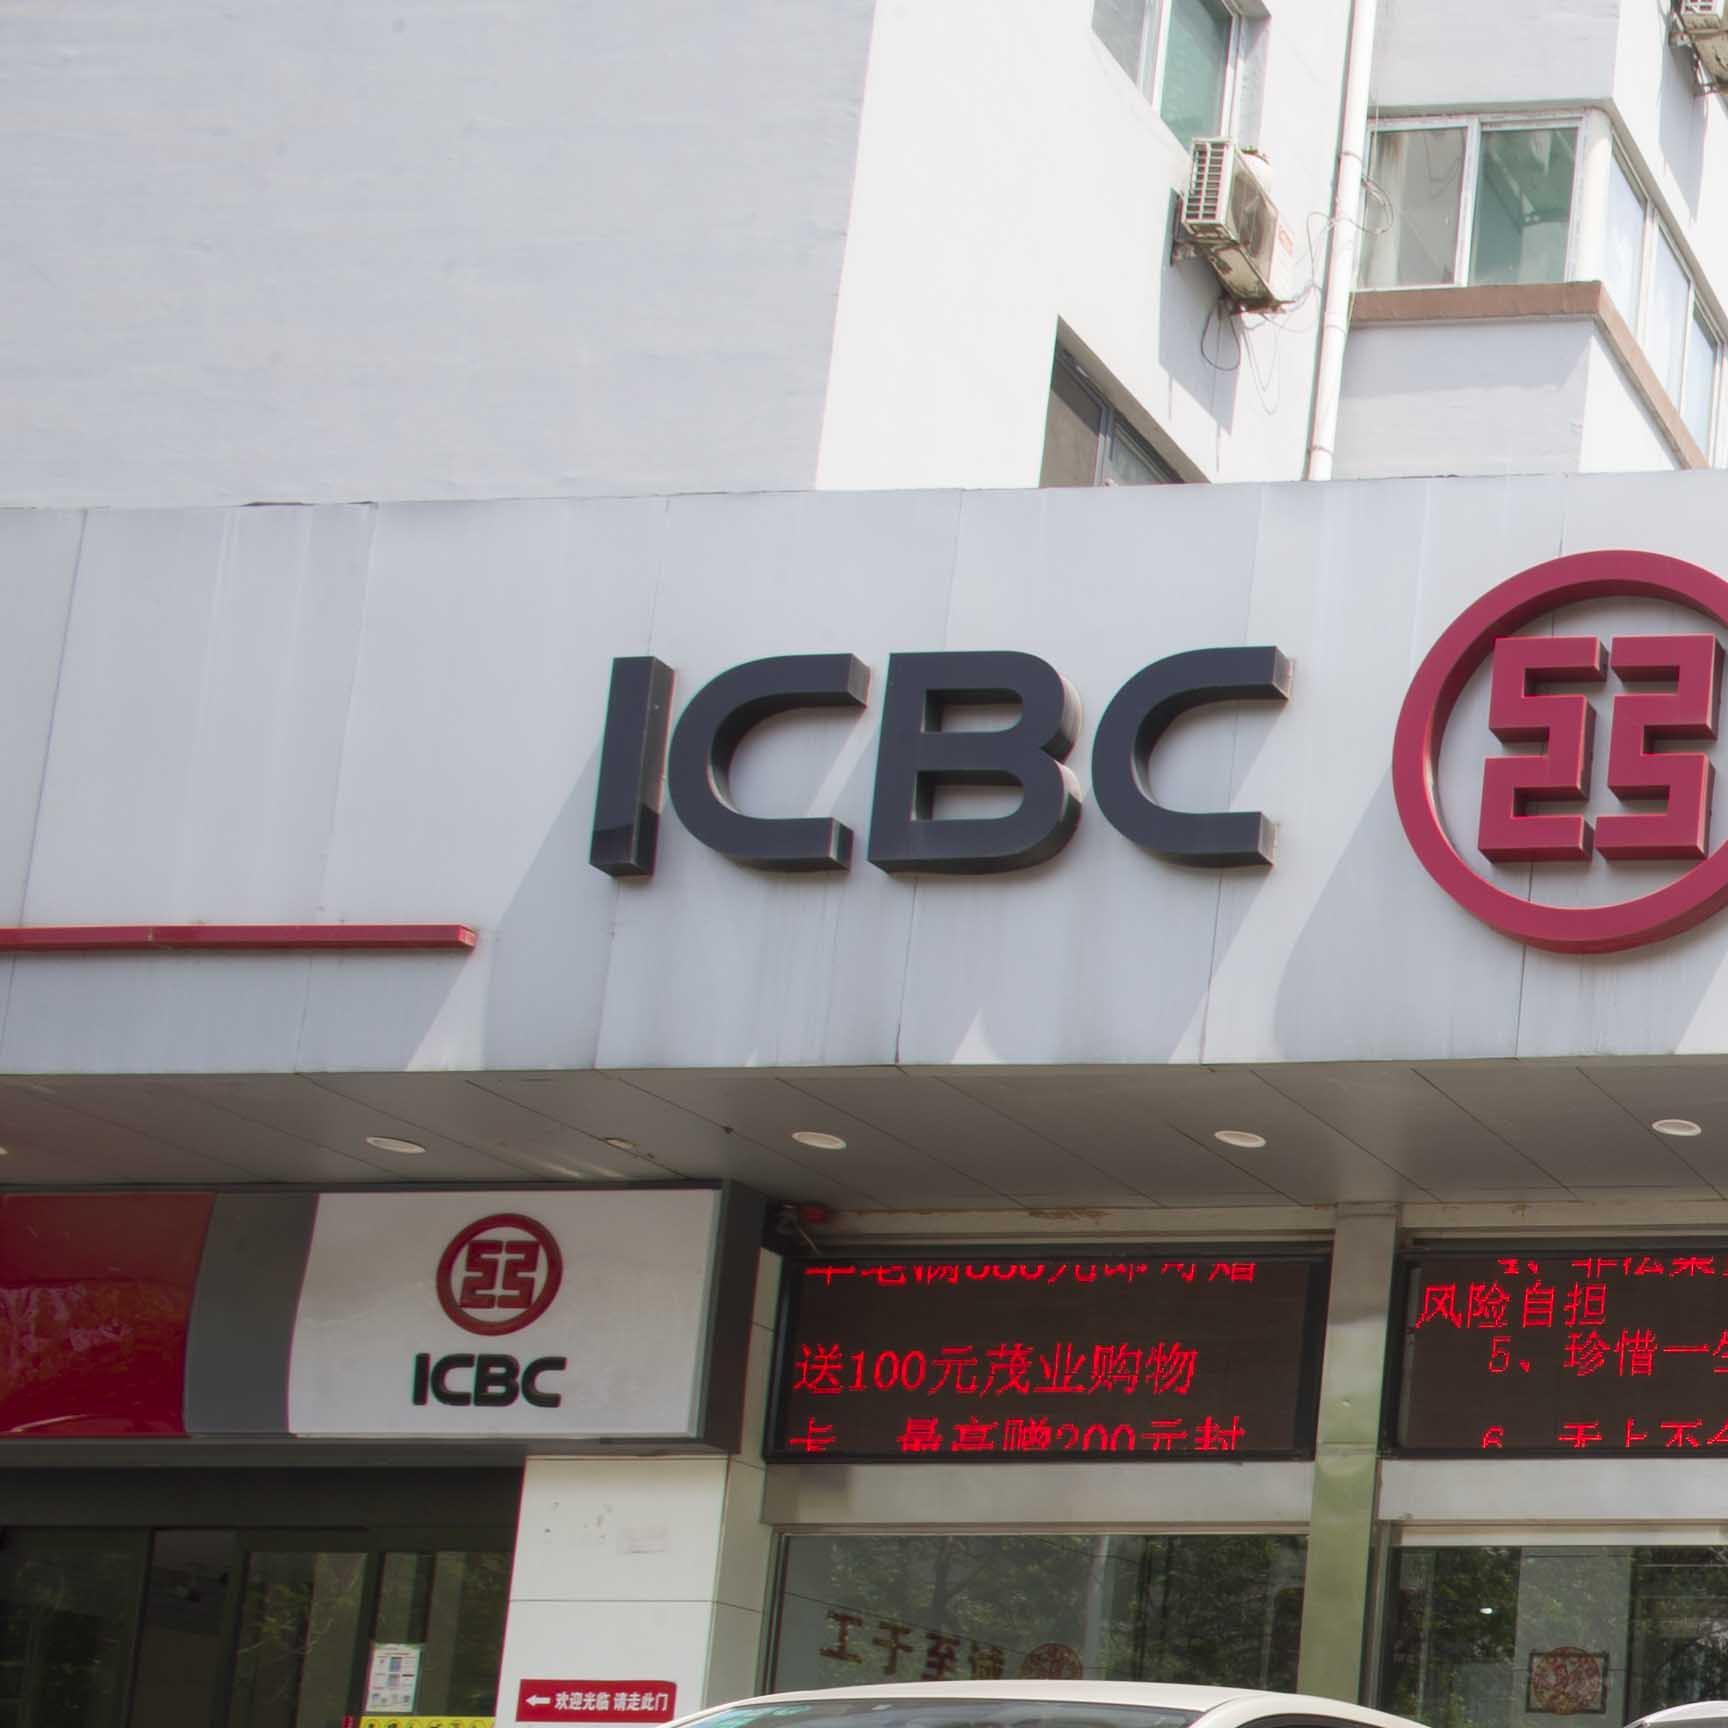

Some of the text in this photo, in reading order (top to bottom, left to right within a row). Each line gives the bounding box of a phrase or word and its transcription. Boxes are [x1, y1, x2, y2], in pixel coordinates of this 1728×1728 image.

[590, 645, 1292, 877] ICBC
[1415, 1279, 1607, 1328] 风险自担
[412, 1352, 567, 1408] ICBC
[793, 1343, 1199, 1397] 送100元茂业购物
[554, 1692, 669, 1712] 欢迎光临 请走此门
